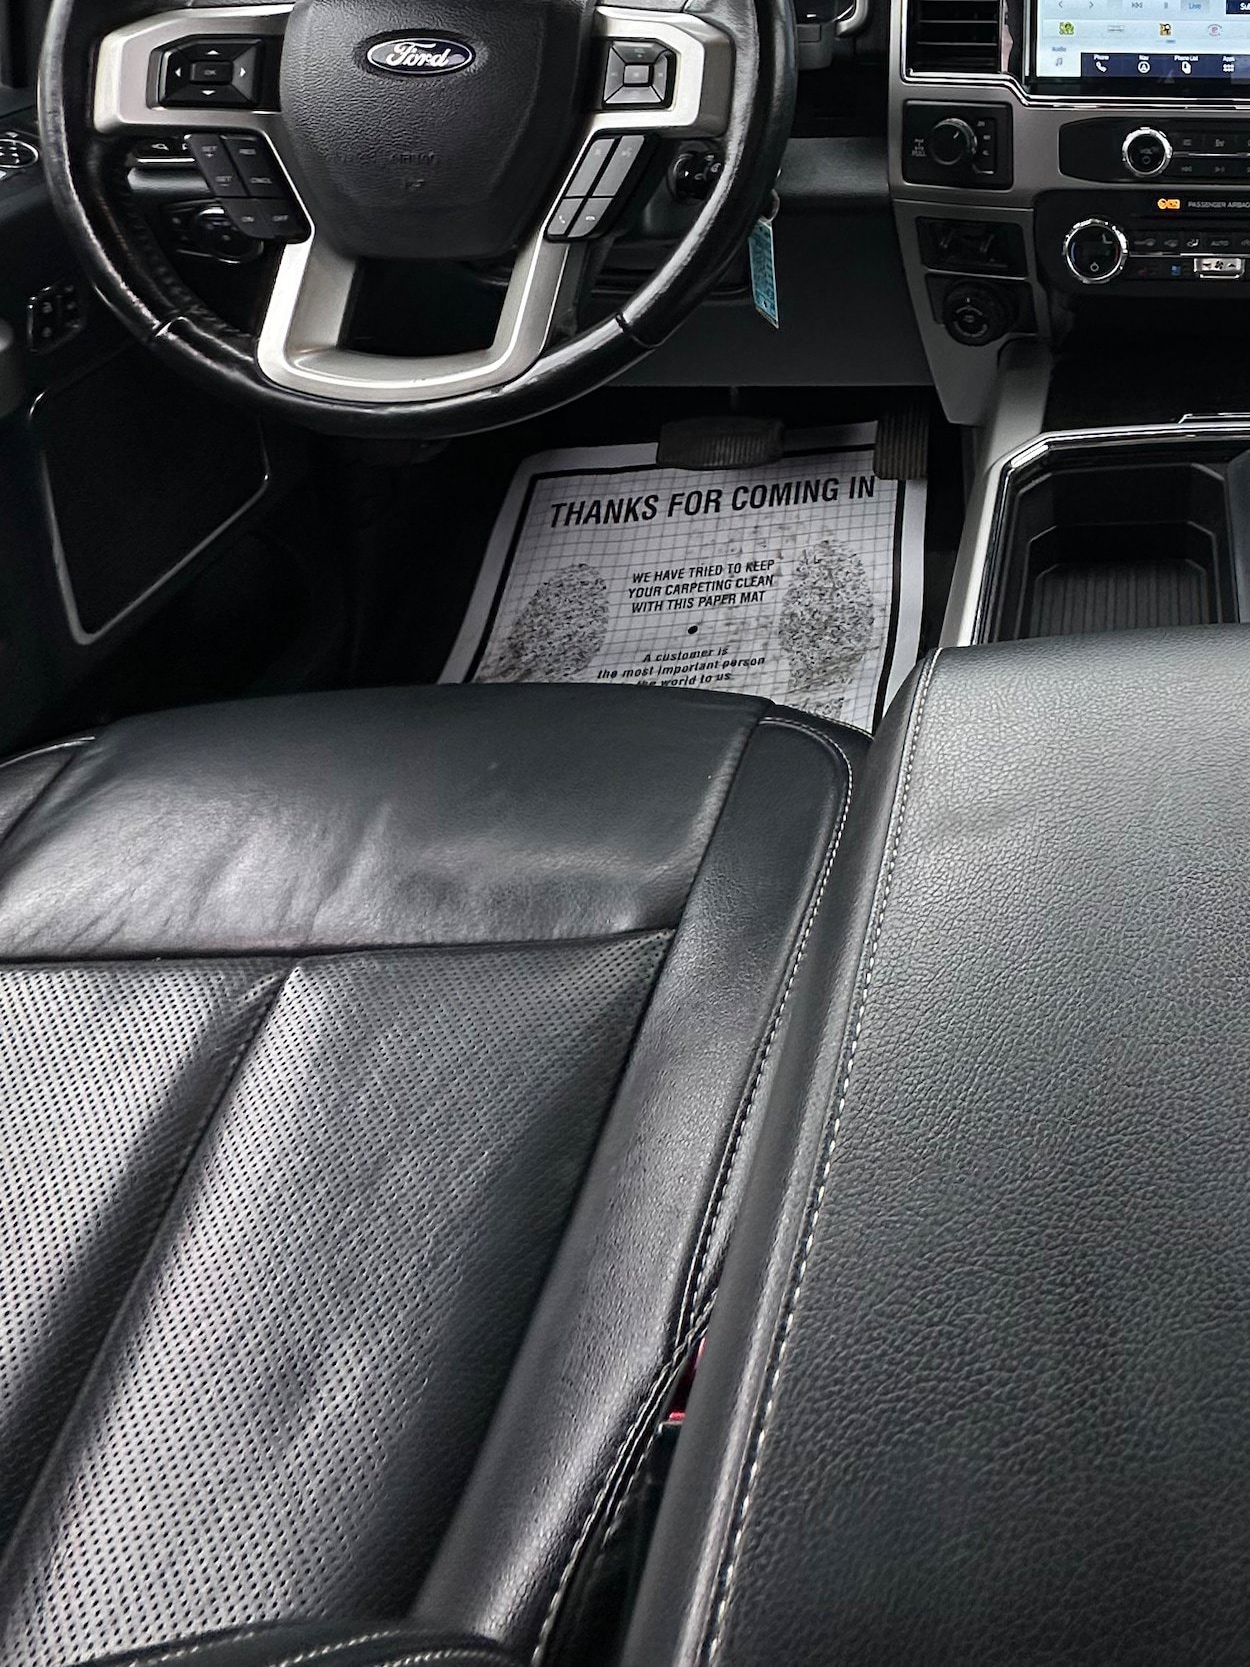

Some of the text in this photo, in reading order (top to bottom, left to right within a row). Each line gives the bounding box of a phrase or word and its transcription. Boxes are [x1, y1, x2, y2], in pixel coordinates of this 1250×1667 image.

[1189, 1, 1202, 10] Live
[386, 41, 452, 68] Ford
[1222, 54, 1235, 63] Apps
[202, 145, 218, 153] SET
[215, 175, 233, 183] SET
[1187, 201, 1250, 209] PASSENGER AIRBAG
[551, 475, 876, 528] THANKS FOR COMING IN
[632, 559, 775, 583] WE HAVE TRIED TO KEEP
[628, 574, 775, 599] YOUR CARPETING CLEAN
[631, 590, 766, 614] WITH THIS PAPER MAT
[642, 647, 729, 663] A customer is
[597, 657, 766, 679] the most important person
[660, 674, 696, 686] world
[700, 674, 712, 684] to
[716, 672, 731, 681] us
